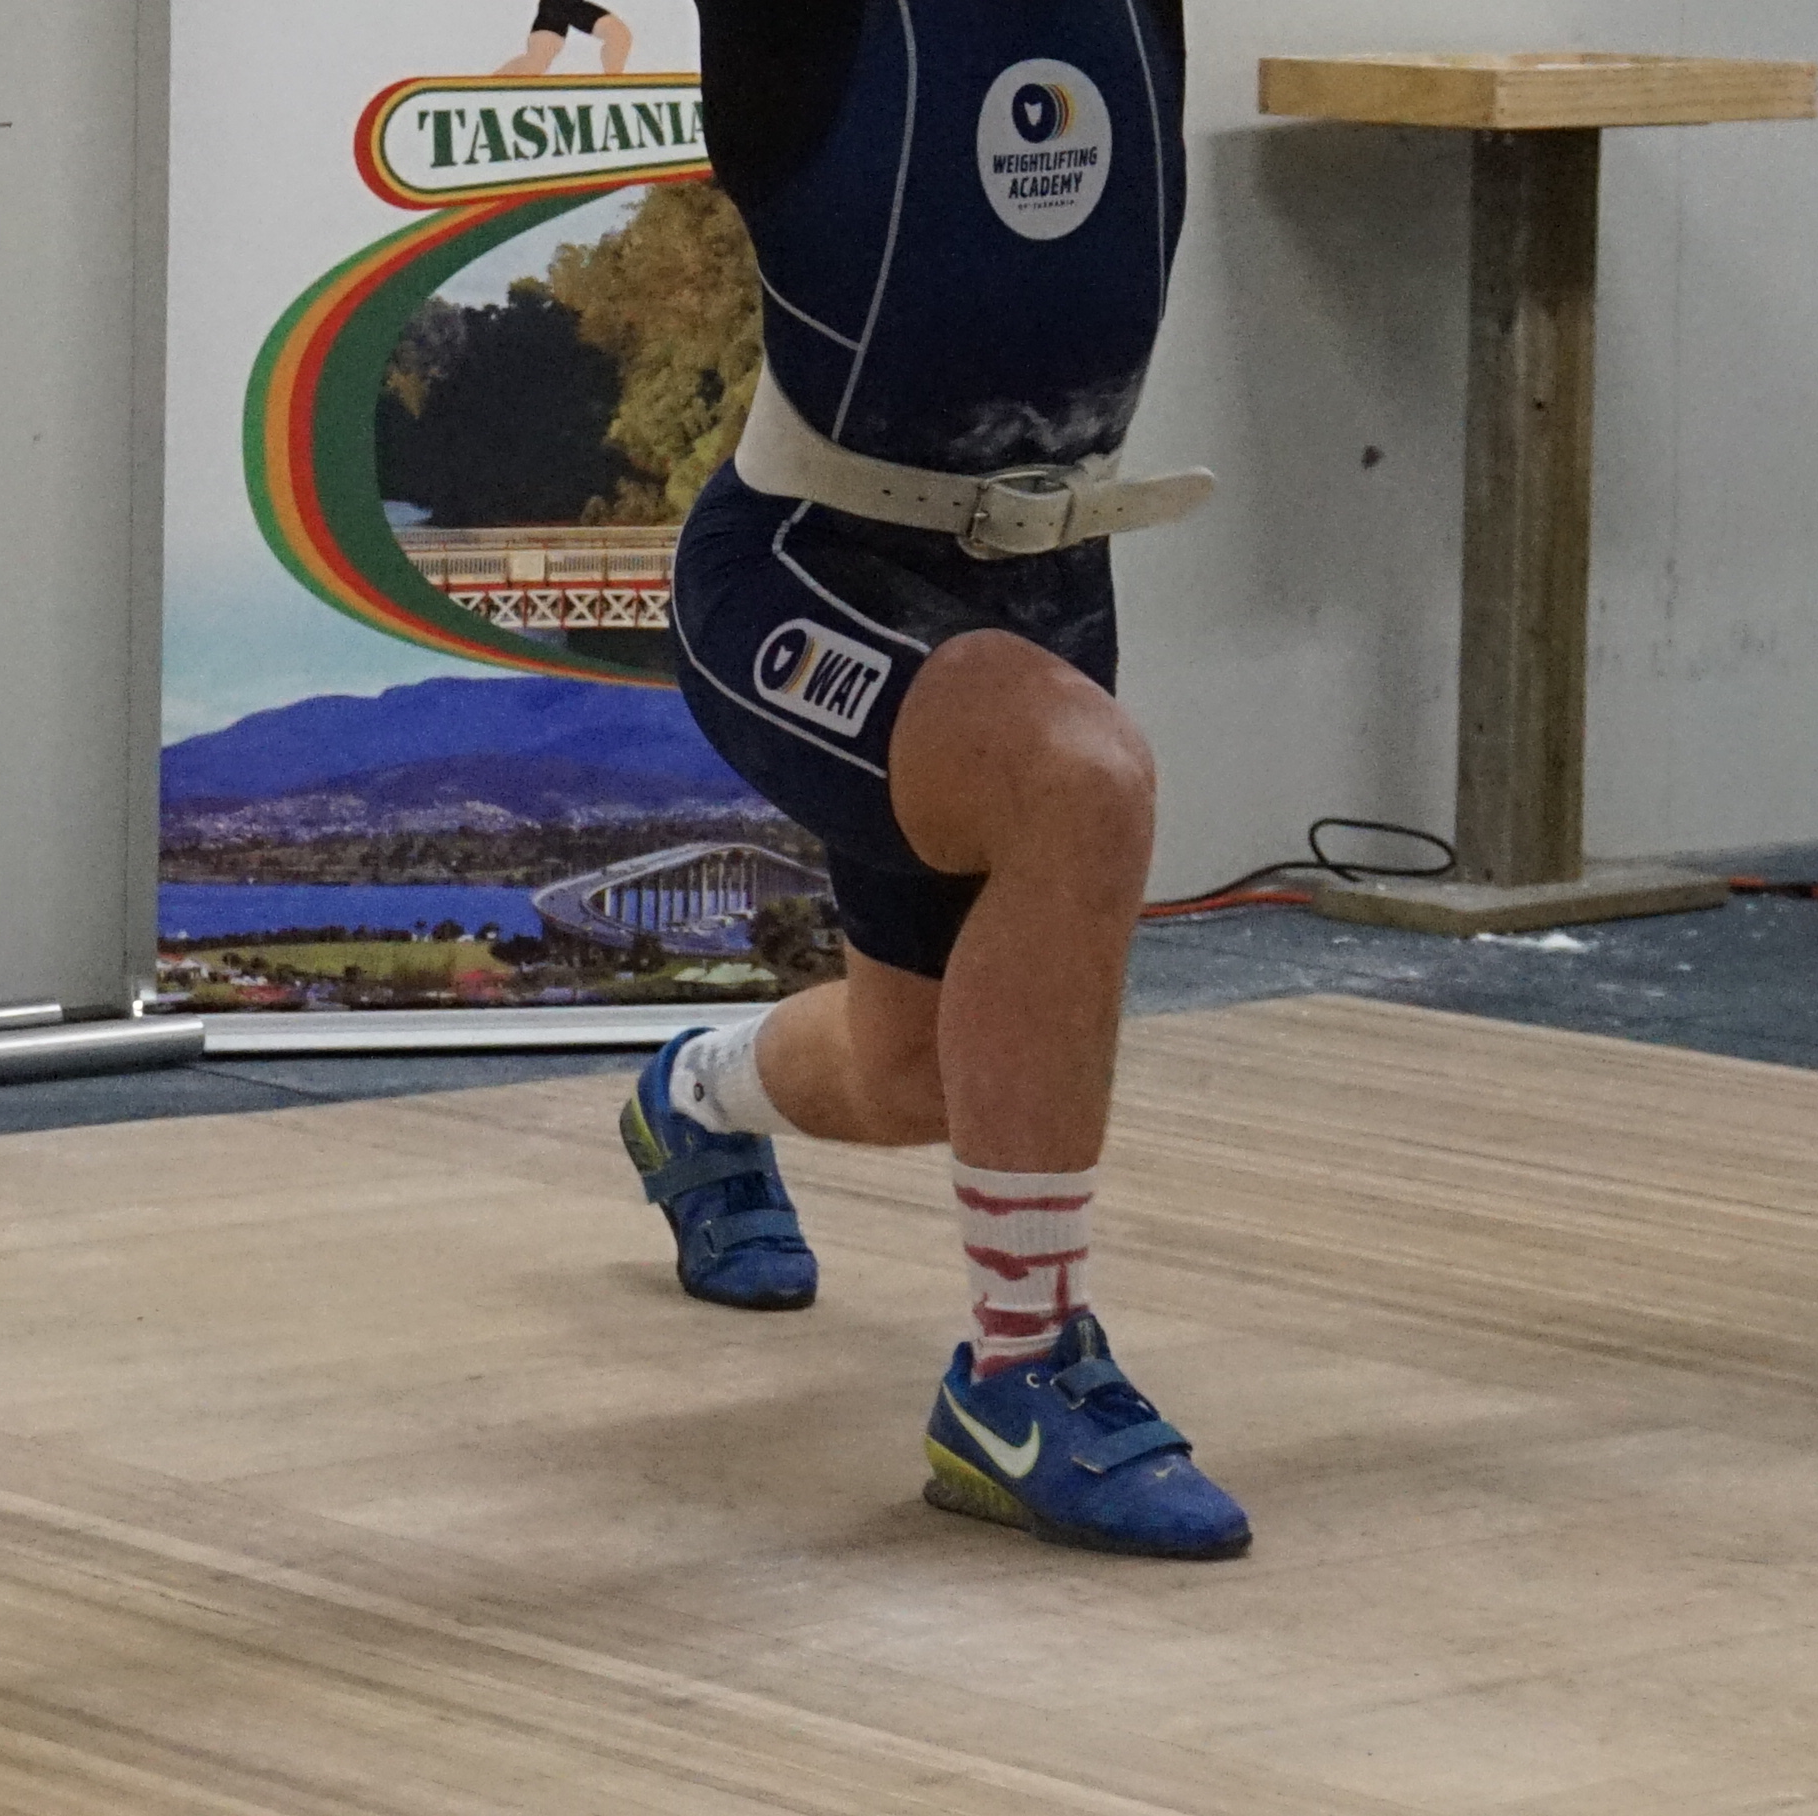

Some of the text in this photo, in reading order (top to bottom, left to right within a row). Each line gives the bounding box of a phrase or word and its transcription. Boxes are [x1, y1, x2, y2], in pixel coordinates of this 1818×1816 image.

[993, 146, 1098, 173] WEIGHTLIFTING
[1008, 171, 1083, 199] ACADEMY
[803, 649, 881, 720] WAT
